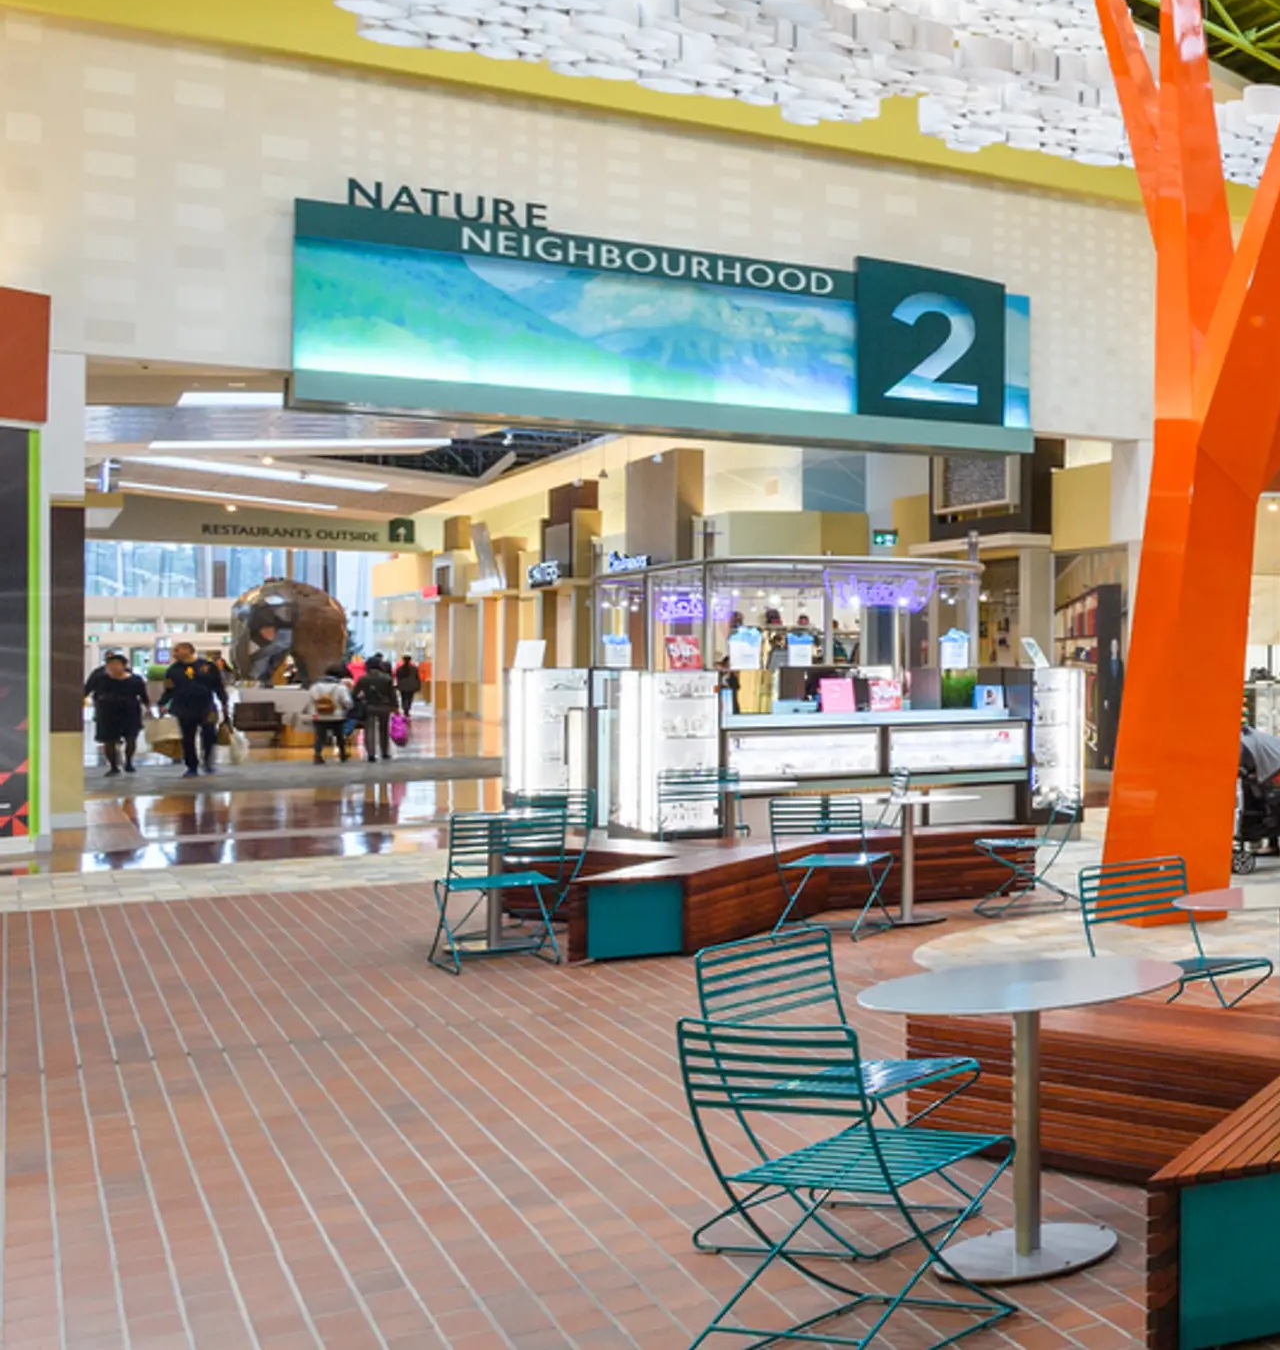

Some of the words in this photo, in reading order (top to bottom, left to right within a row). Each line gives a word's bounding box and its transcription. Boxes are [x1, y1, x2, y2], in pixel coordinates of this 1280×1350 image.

[346, 177, 549, 230] NATURE
[460, 226, 835, 295] NEIGHBOURHOOD
[883, 290, 979, 406] 2
[201, 523, 311, 540] RESTAURANTS
[315, 528, 380, 542] OUTSIDE
